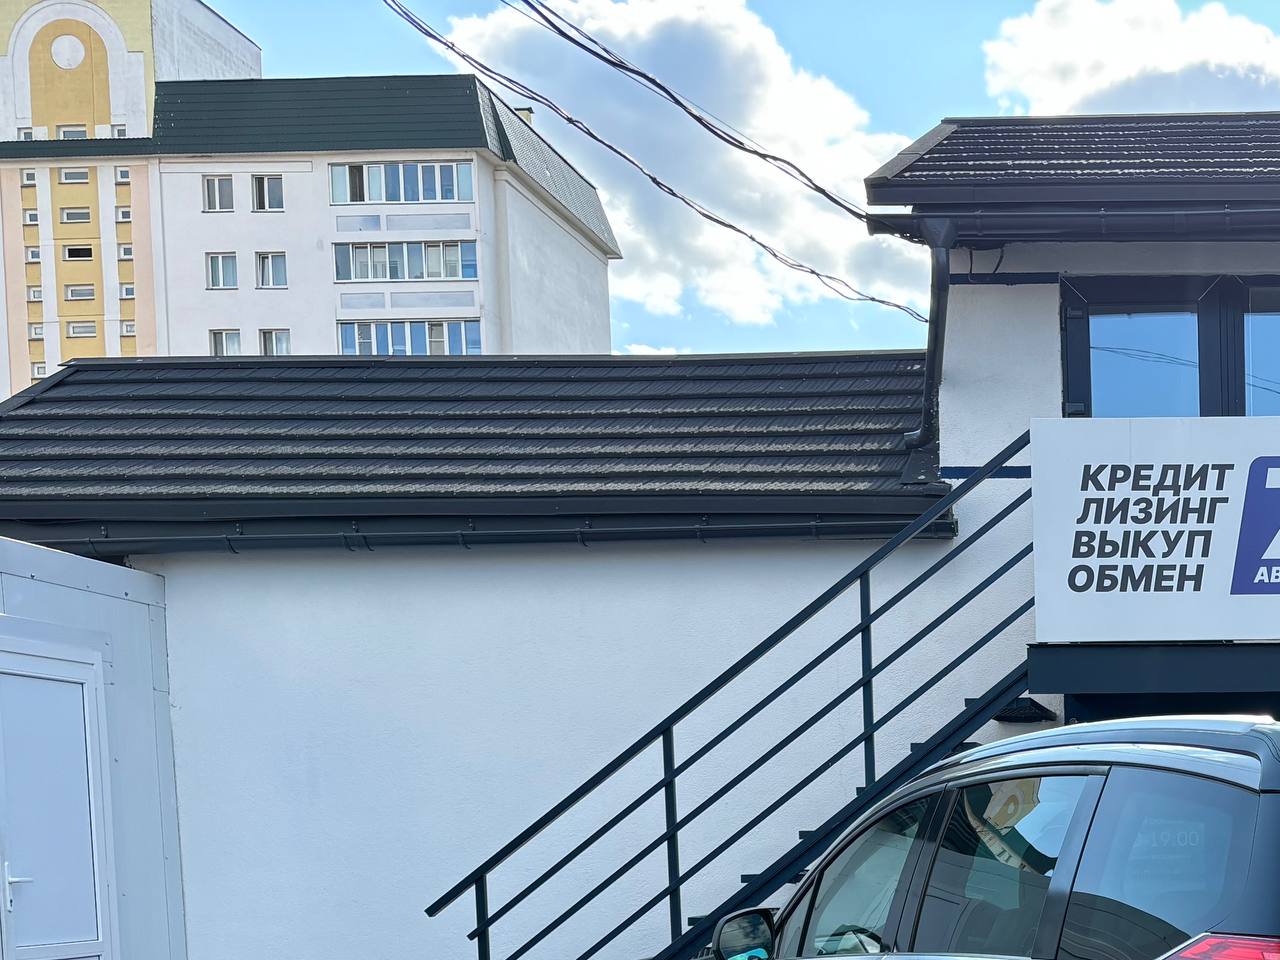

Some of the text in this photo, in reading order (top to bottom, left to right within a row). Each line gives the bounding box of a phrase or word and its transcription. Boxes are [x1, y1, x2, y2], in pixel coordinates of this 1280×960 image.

[1080, 464, 1235, 497] КРЕДИТ
[1076, 496, 1230, 525] ЛИЗИНГ
[1071, 530, 1213, 559] ВЫКУП
[1067, 564, 1205, 593] ОБМЕН
